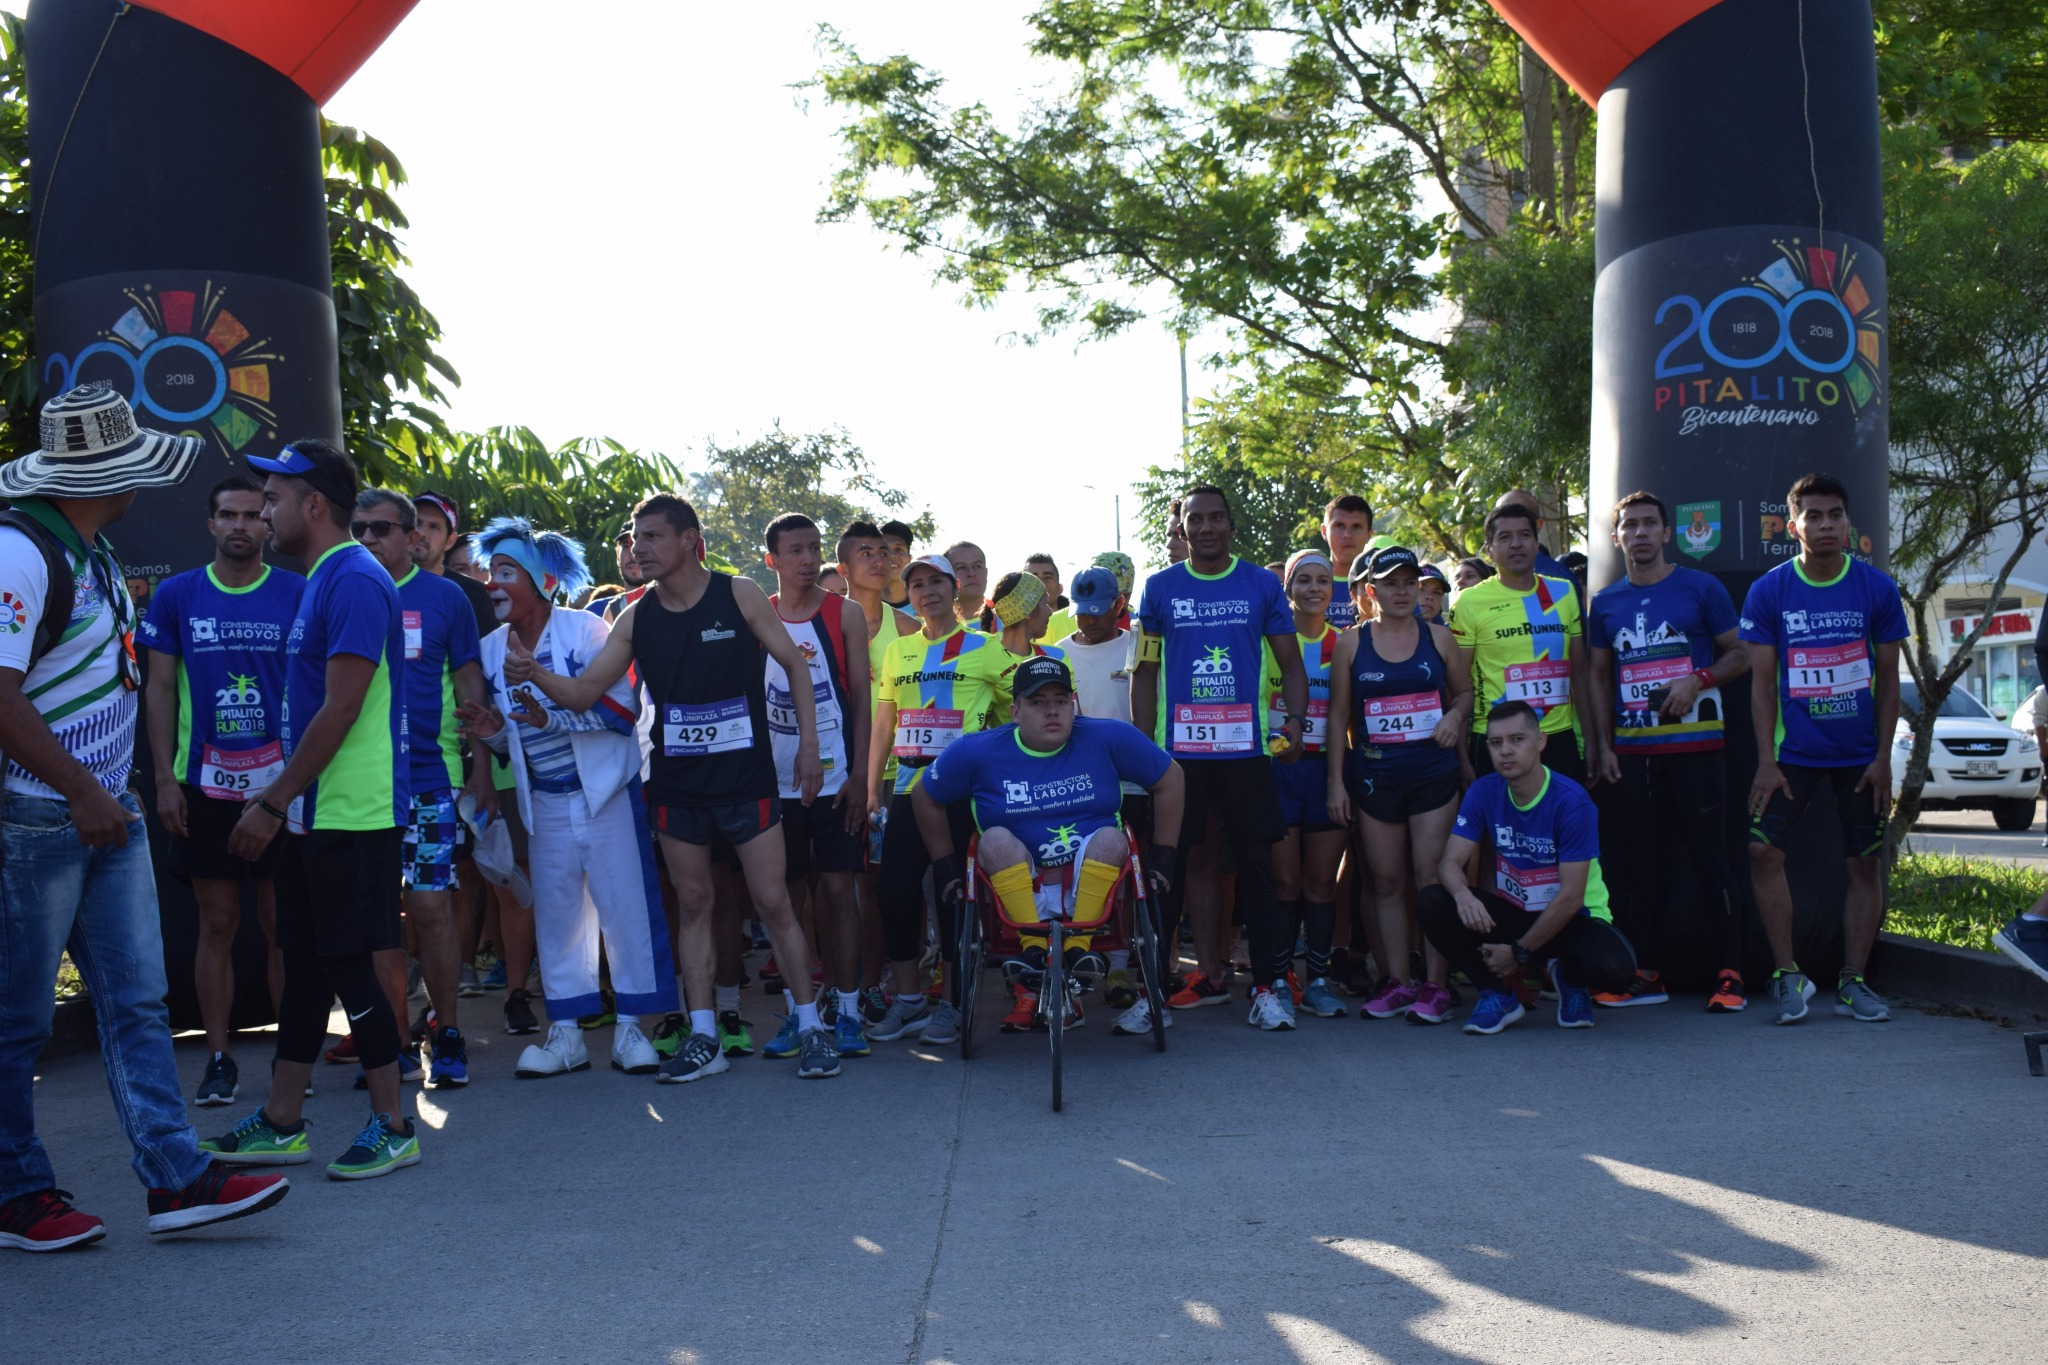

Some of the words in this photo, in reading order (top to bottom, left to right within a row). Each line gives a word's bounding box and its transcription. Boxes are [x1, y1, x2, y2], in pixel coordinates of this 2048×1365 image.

[1654, 287, 1855, 380] 200
[1732, 323, 1757, 334] 1818
[1809, 325, 1833, 338] 2018
[166, 374, 195, 386] 2018
[1655, 376, 1839, 412] PITALITO
[1679, 403, 1820, 435] Bicentenario
[1760, 502, 1790, 514] Som
[125, 564, 171, 577] Somos
[1197, 600, 1249, 609] CONSTRUCTORA
[1198, 606, 1250, 617] LABOYOS
[1810, 611, 1863, 620] CONSTRUCTORA
[220, 621, 280, 631] CONSTRUCTORA
[1810, 617, 1864, 629] LABOYOS
[221, 629, 281, 640] LABOYOS
[1192, 658, 1232, 675] 200
[1808, 656, 1841, 665] UNIPLAZA
[893, 670, 966, 687] UPERUNNERS
[1196, 675, 1235, 687] PITALITO
[1801, 669, 1834, 684] 111
[1520, 681, 1551, 696] 113
[215, 687, 261, 706] 200
[221, 708, 265, 720] PITALITO
[1383, 703, 1414, 712] UNIPLAZA
[684, 712, 718, 722] UNIPLAZA
[1379, 716, 1414, 732] 244
[679, 726, 717, 743] 429
[907, 730, 932, 744] 115
[1186, 726, 1217, 741] 151
[1966, 743, 1991, 751] JMC
[214, 770, 250, 789] 095
[1033, 773, 1090, 792] CONSTRUCTORA
[1034, 779, 1094, 800] LABOYOS
[1516, 838, 1557, 854] LAOYOS
[1505, 878, 1528, 902] 035
